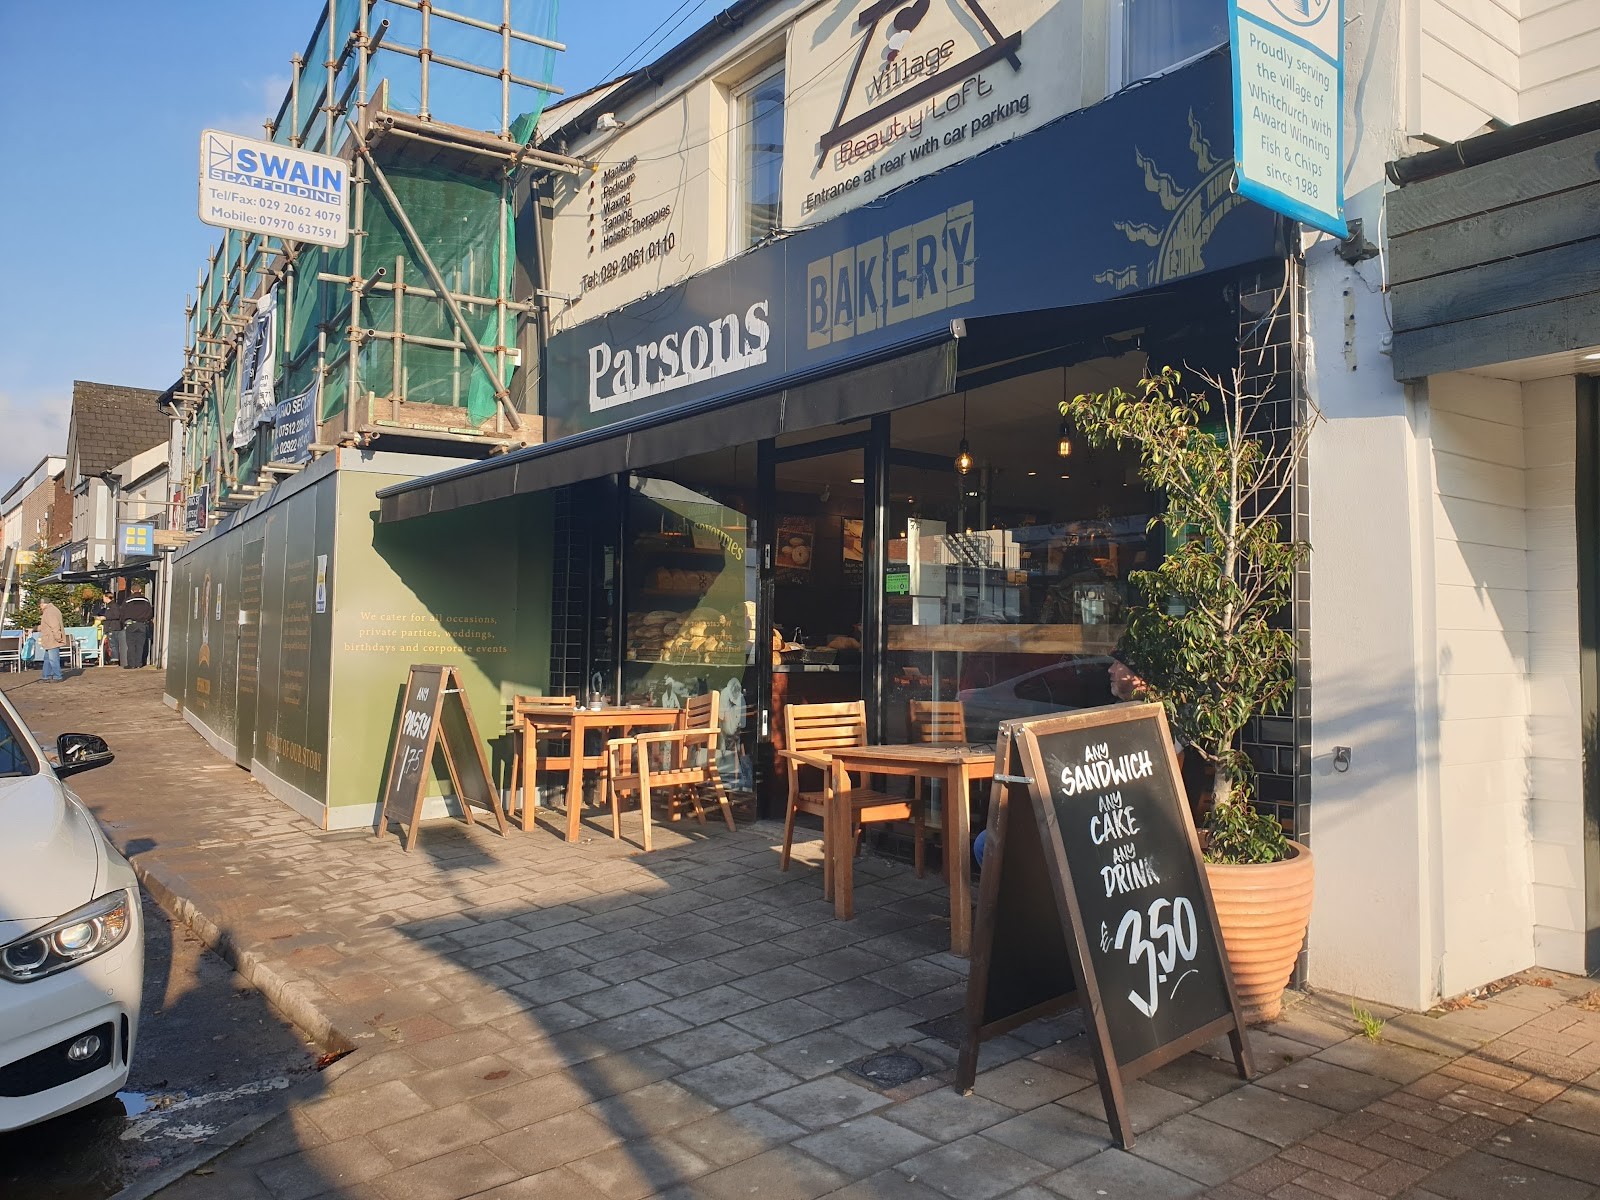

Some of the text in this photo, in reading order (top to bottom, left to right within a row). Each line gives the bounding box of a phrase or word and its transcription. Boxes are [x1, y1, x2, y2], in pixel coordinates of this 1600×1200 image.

[871, 39, 955, 97] Village
[1249, 32, 1330, 92] Proudly serving
[1257, 62, 1324, 110] the village of
[1248, 81, 1332, 139] Whitchurch with
[806, 92, 1030, 210] Entrance at rear with car parking
[840, 109, 923, 164] Beauty
[1253, 105, 1330, 160] Award Winning
[236, 148, 342, 193] SWAIN
[1261, 134, 1322, 177] Fish & Chips
[211, 169, 341, 205] SCAFFOLDING
[603, 172, 636, 199] Pedicure
[1266, 164, 1319, 200] since 1988
[209, 187, 341, 223] Tel/Fax: 029 2062 4079
[211, 206, 337, 239] Mobile: 07970 637591
[603, 192, 631, 215] Waxing
[603, 208, 633, 230] Tanning
[603, 204, 671, 247] Holistic Therapies
[582, 232, 675, 291] Tel: 029 2061 0110
[809, 218, 972, 337] BAKERY
[588, 299, 770, 411] Parsons
[359, 627, 495, 640] private parties, weddings,
[360, 611, 498, 625] We cater for all occasions,
[344, 643, 507, 654] birthdays and corporate events
[416, 686, 430, 701] ANY
[403, 709, 432, 740] PASTY
[1084, 741, 1109, 764] ANY
[1060, 750, 1153, 797] SANDWICH
[1098, 790, 1123, 813] ANY
[1090, 805, 1140, 845] CAKE
[1112, 842, 1136, 865] ANY
[1100, 857, 1161, 898] DRINK
